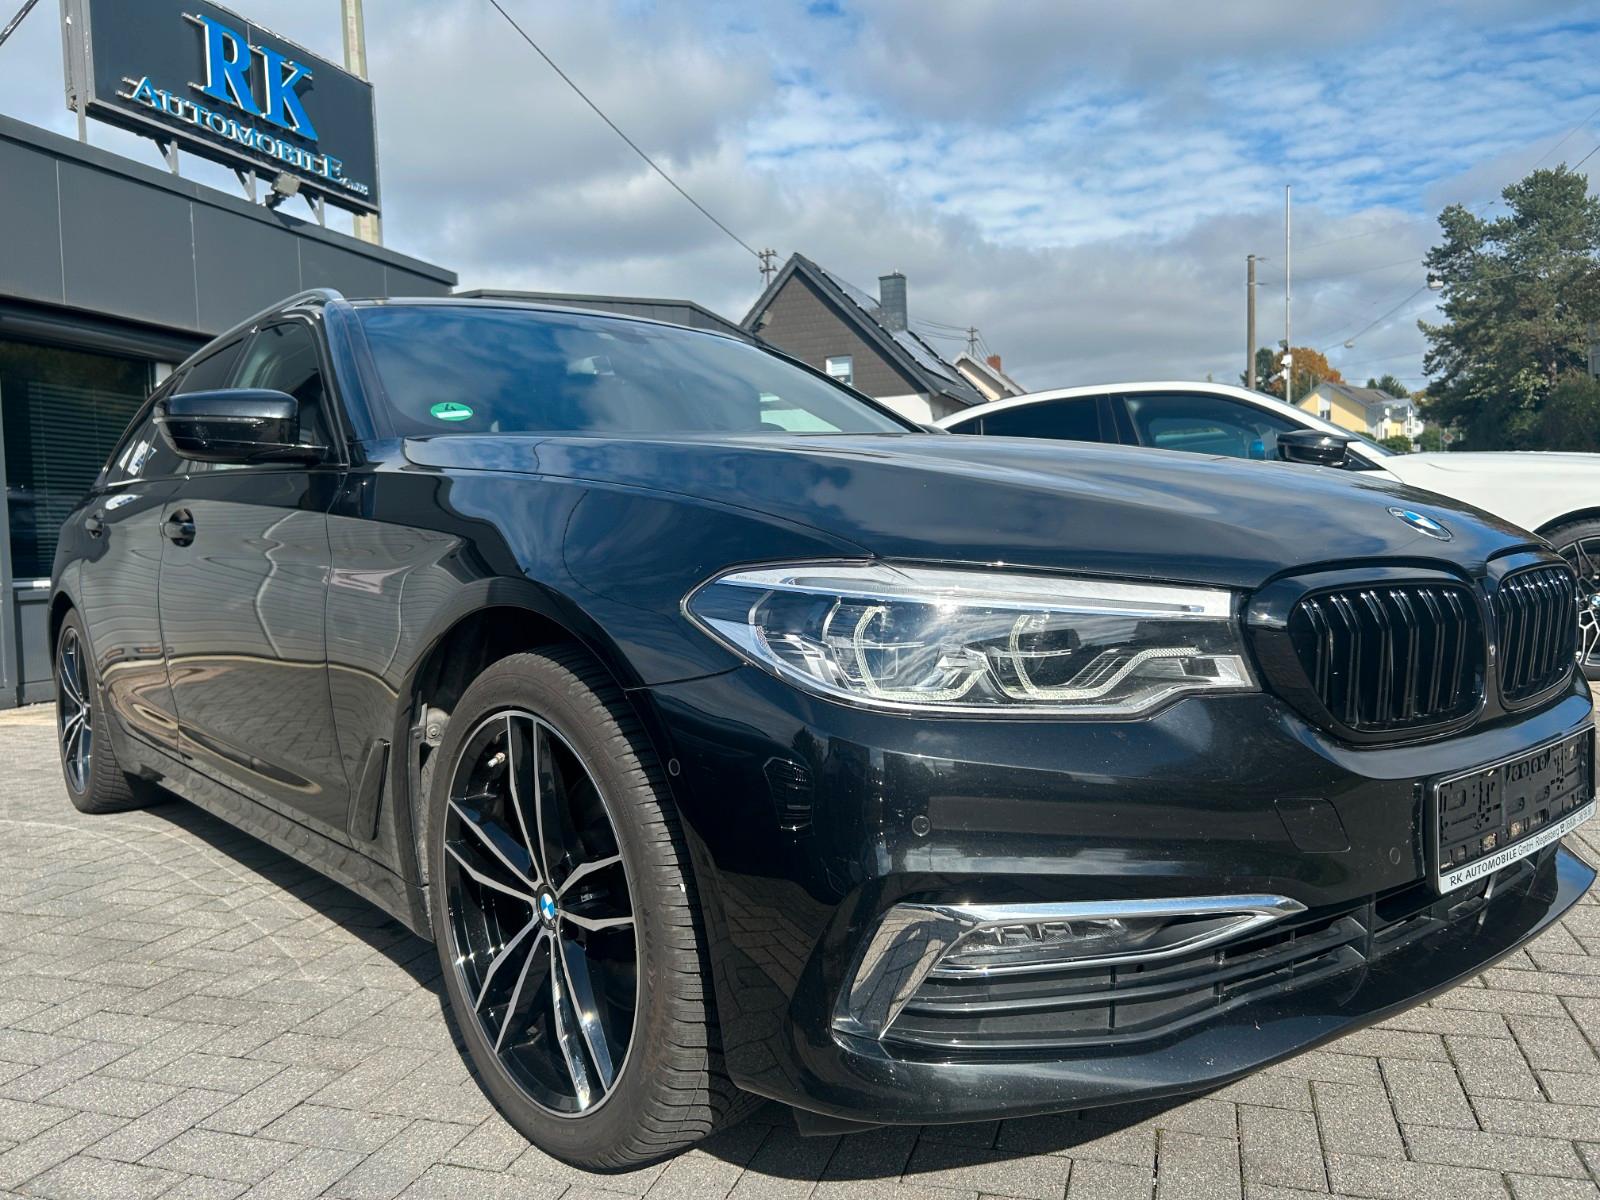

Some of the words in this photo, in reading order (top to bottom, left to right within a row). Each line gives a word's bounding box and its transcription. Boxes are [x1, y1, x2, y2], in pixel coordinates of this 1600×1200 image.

[116, 76, 344, 184] AUTOMOBILE
[182, 12, 318, 141] RK
[1450, 873, 1463, 886] RK
[1466, 848, 1517, 879] AUTOMOBILE
